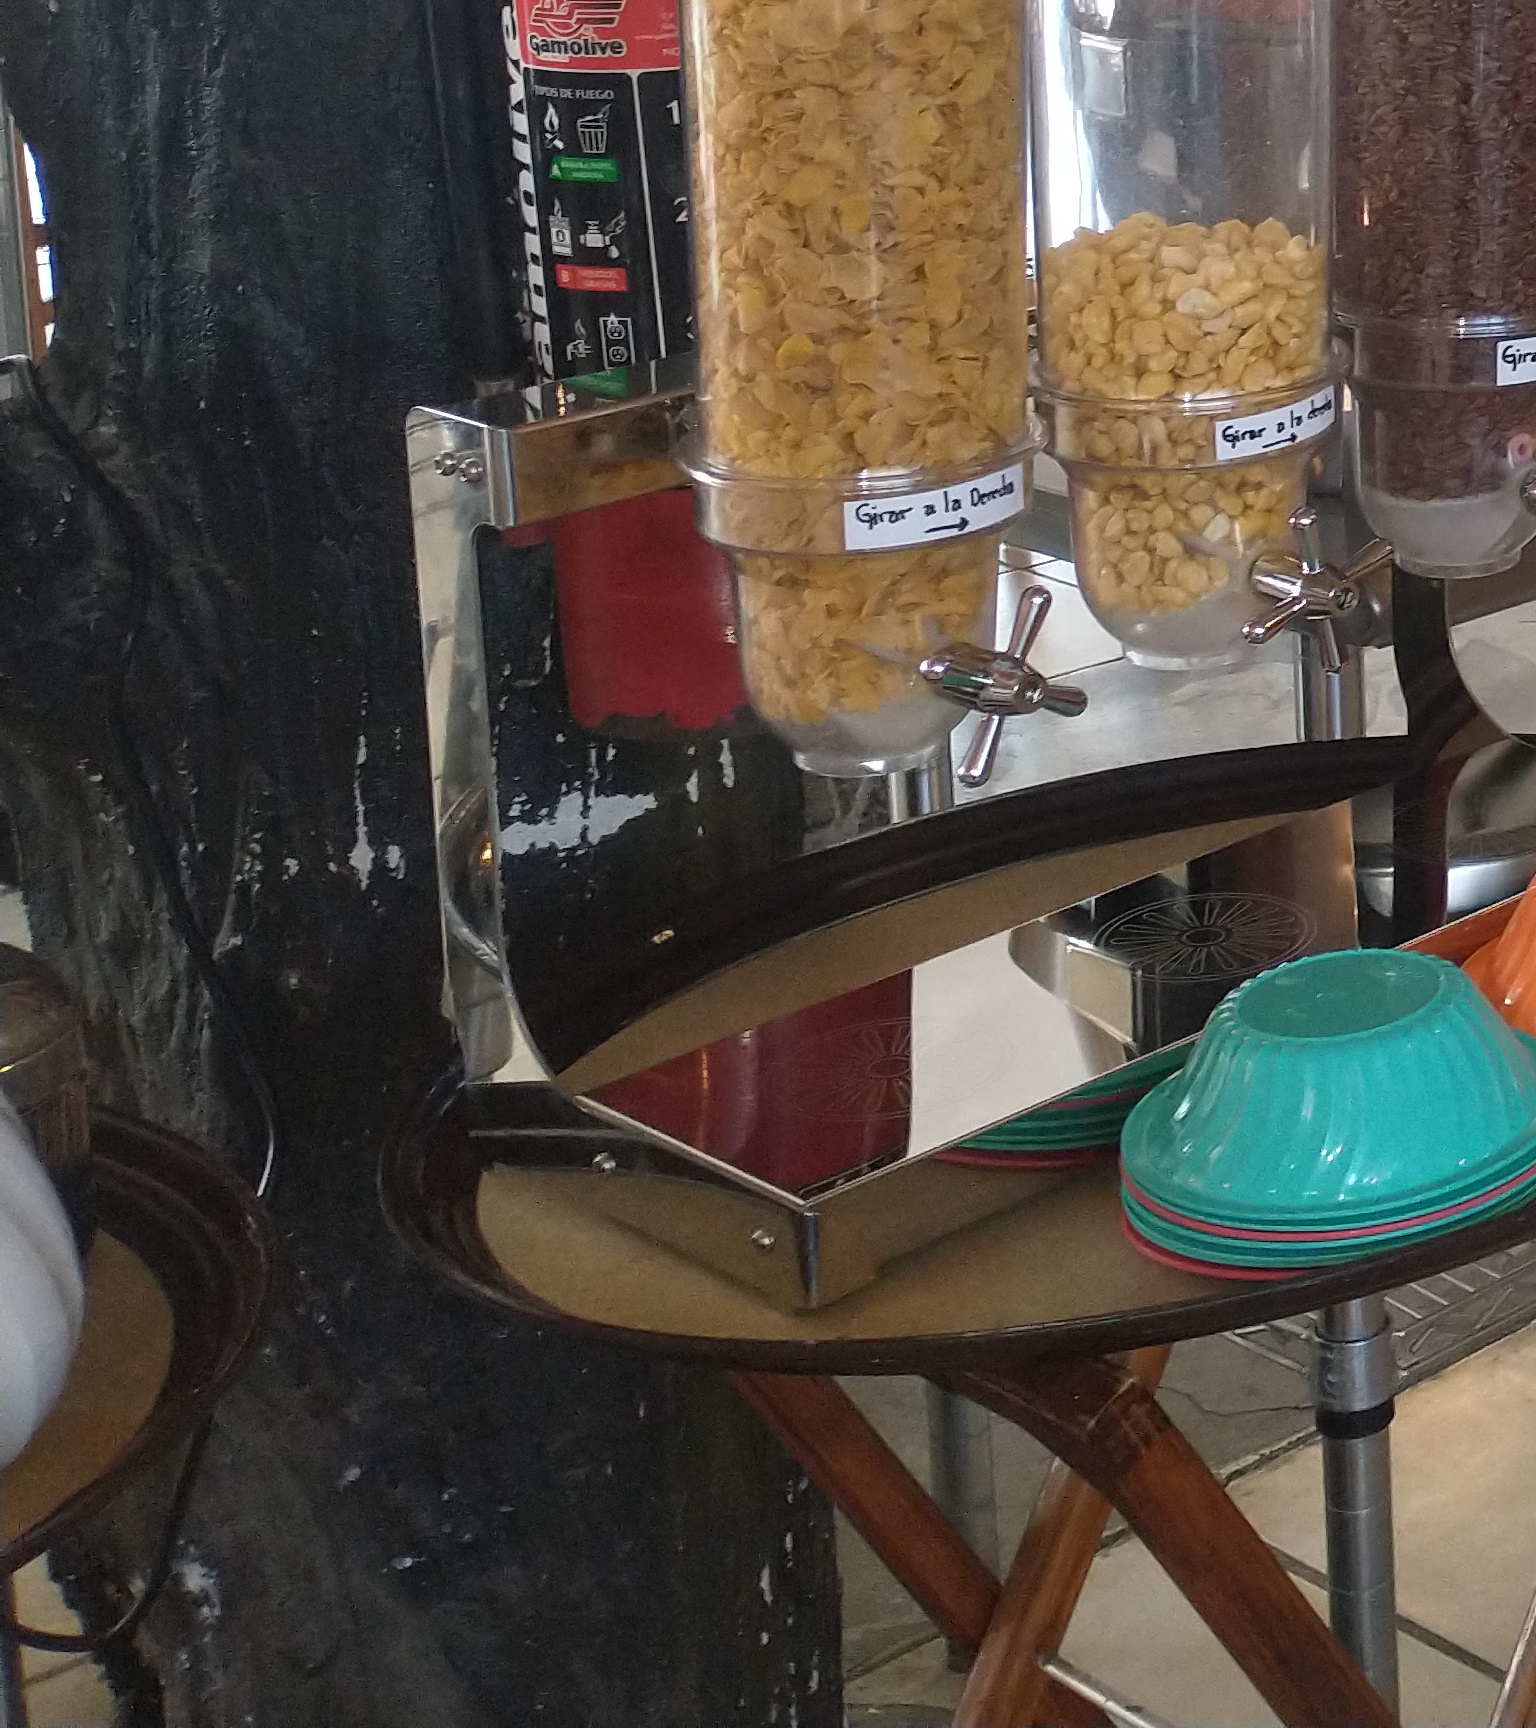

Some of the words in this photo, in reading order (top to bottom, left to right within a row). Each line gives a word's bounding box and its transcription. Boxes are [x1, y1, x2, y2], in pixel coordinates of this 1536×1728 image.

[529, 34, 626, 56] Gamolive
[560, 88, 574, 98] DE
[575, 89, 615, 100] FUEGO
[1222, 425, 1266, 449] Girar
[855, 502, 913, 530] Girar
[943, 490, 962, 513] la
